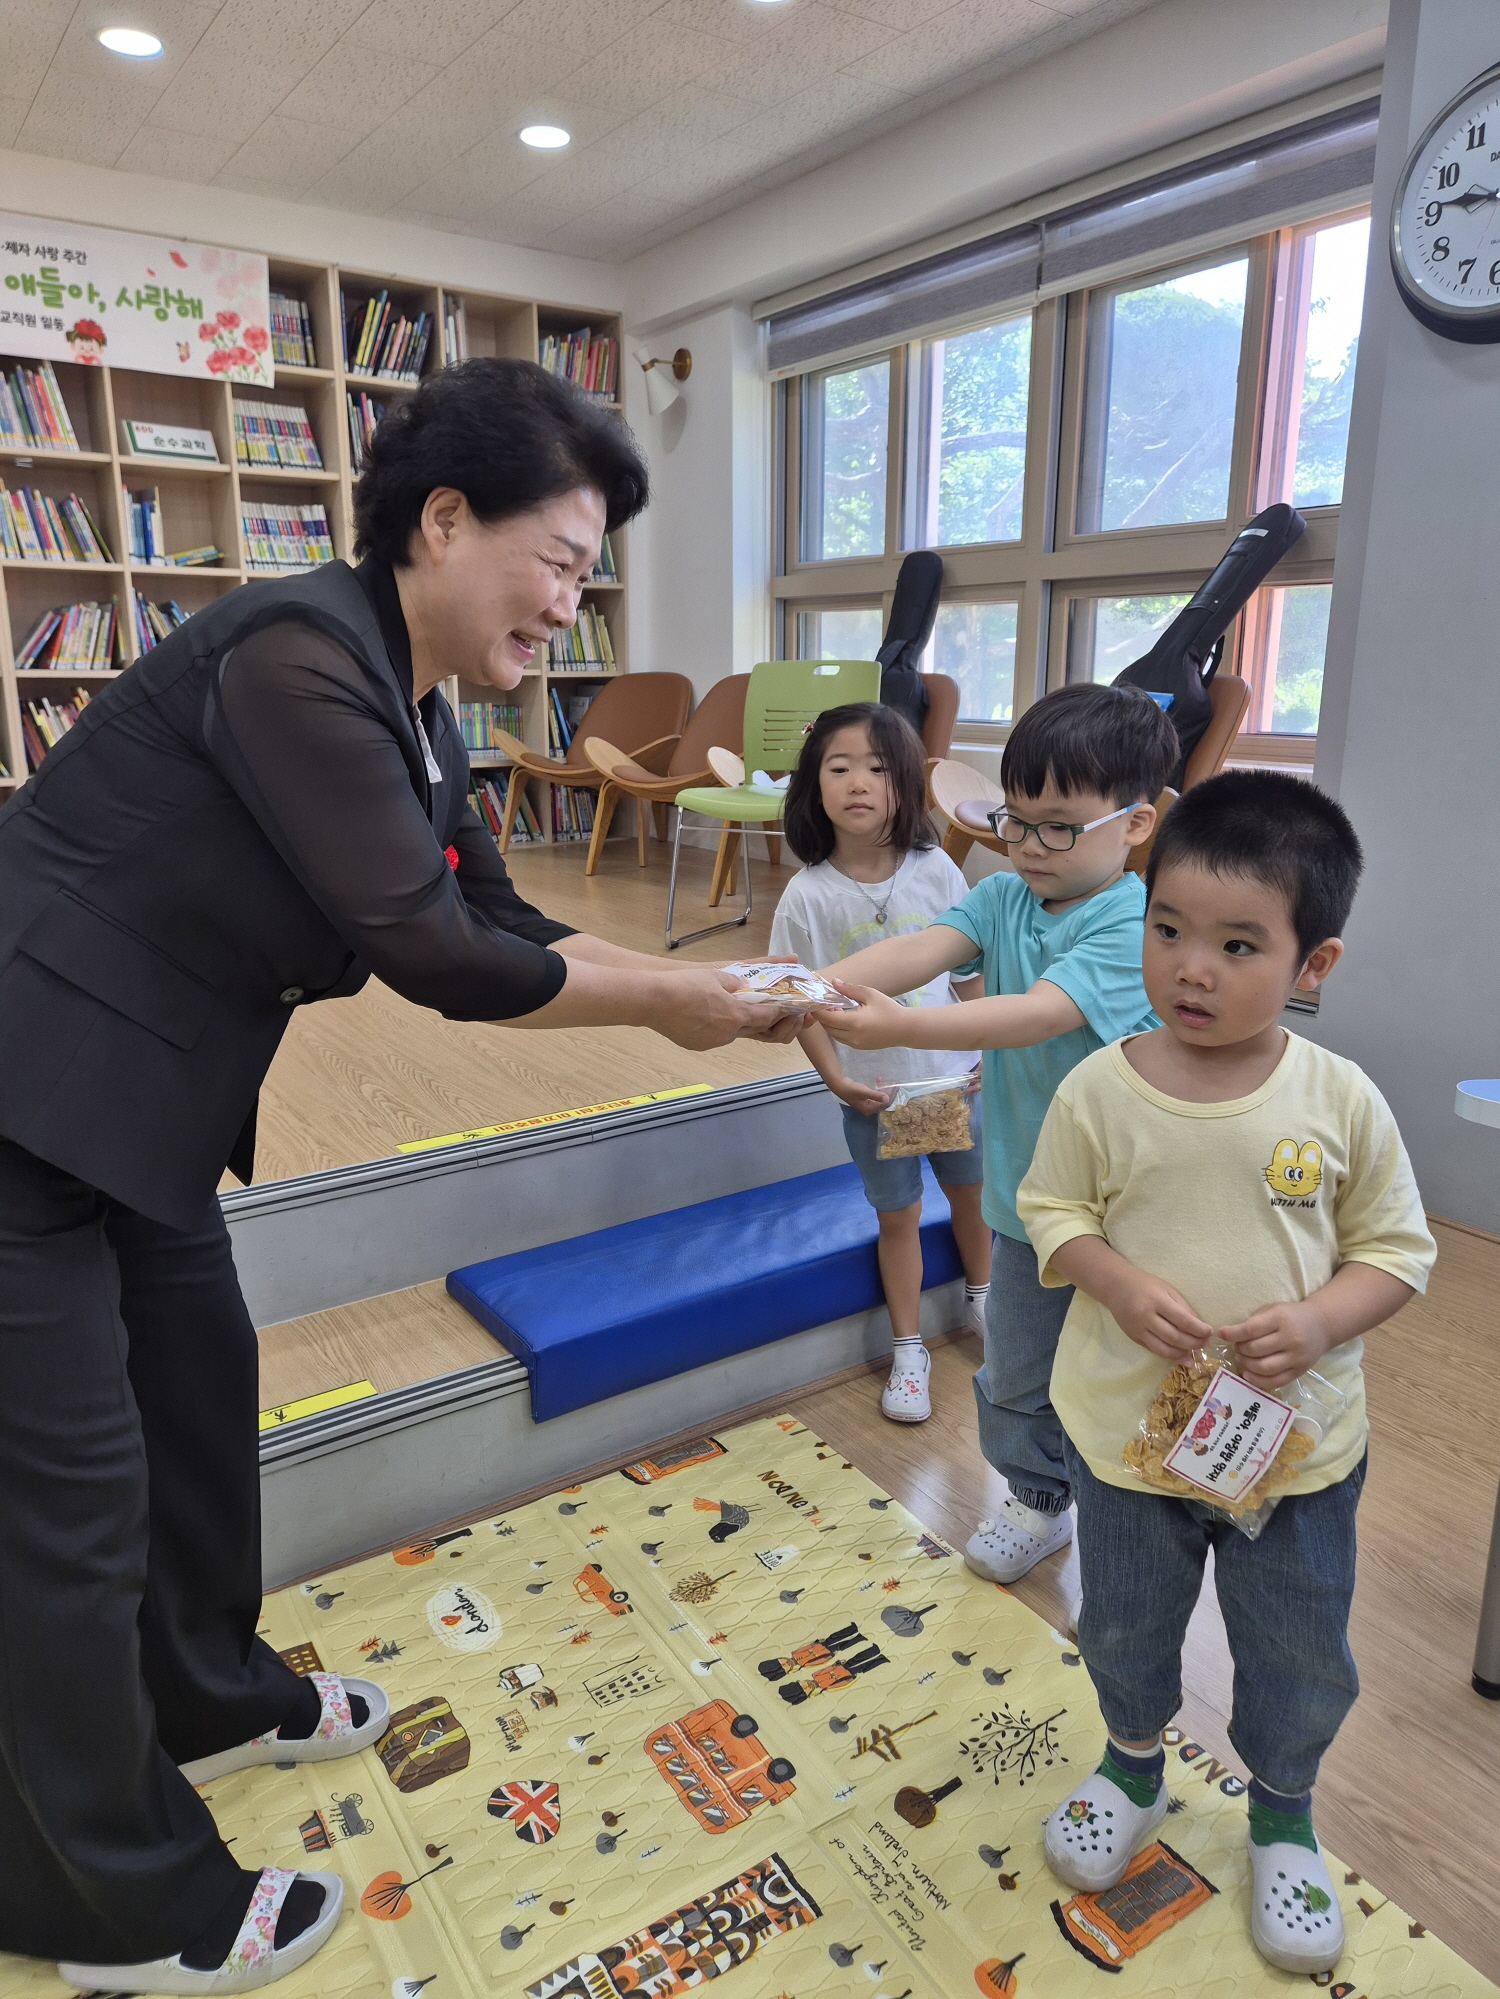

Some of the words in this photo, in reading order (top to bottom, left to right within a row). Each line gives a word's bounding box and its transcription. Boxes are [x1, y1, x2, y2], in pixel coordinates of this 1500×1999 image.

[1466, 122, 1486, 151] 11
[1437, 162, 1460, 190] 10
[1425, 201, 1443, 226] 9
[34, 245, 59, 261] 사랑
[63, 249, 88, 266] 주간
[1431, 236, 1450, 262] 8
[1458, 257, 1478, 285] 7
[115, 284, 204, 322] 사랑해
[0, 311, 37, 328] 교직원
[41, 316, 64, 332] 일동
[154, 436, 206, 451] 순수과학
[574, 1099, 634, 1115] 계단조심!
[1219, 1433, 1243, 1463] 아침밥
[1205, 1462, 1227, 1482] 먹자!
[756, 1469, 820, 1517] LONDON
[828, 1838, 846, 1849] of
[867, 1821, 909, 1868] Ireland
[847, 1852, 890, 1904] Kingdom
[862, 1843, 898, 1888] Britain
[911, 1862, 952, 1911] Northern
[896, 1889, 925, 1922] Great
[887, 1908, 927, 1952] United
